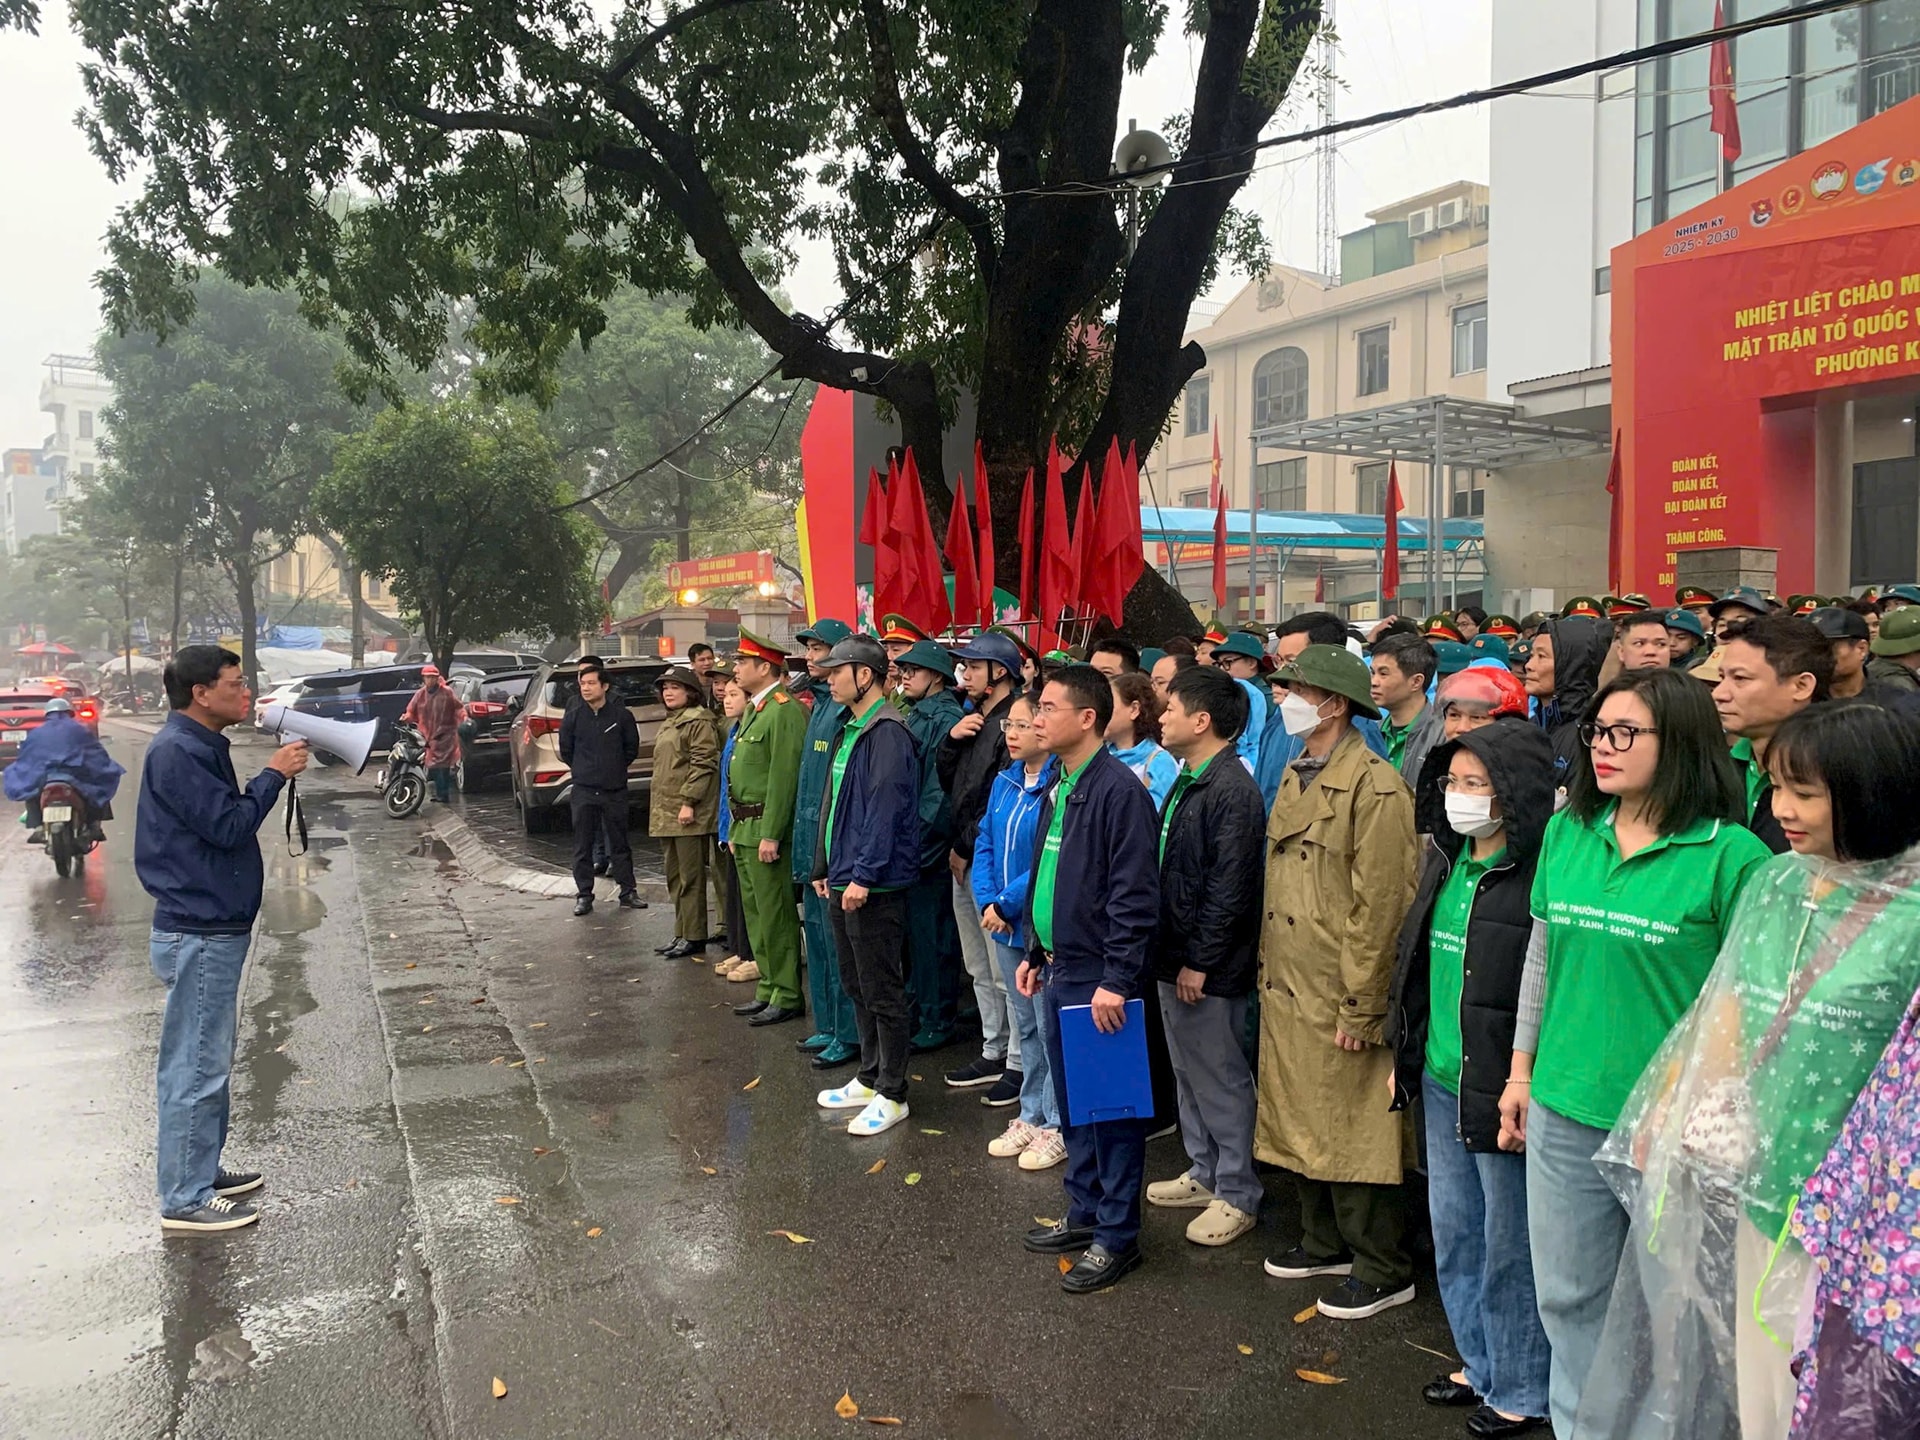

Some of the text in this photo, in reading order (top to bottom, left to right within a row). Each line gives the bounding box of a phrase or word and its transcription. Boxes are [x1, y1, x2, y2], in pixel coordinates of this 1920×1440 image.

[1664, 239, 1695, 257] 2025
[1706, 227, 1739, 246] 2030
[1735, 300, 1788, 329] NHIỆT
[1793, 290, 1833, 318] LIỆT
[1838, 279, 1894, 308] CHÀO
[1723, 335, 1763, 361] MẶT
[1767, 326, 1818, 352] TRẬN
[1823, 313, 1848, 343] TỔ
[1853, 304, 1909, 339] QUỐC
[1815, 345, 1899, 376] PHƯỜNG
[1672, 452, 1719, 473] ĐOÀN KẾT,
[1672, 473, 1719, 493] ĐOÀN KẾT,
[1664, 492, 1728, 516] ĐẠI ĐOÀN KẾT
[1665, 527, 1727, 545] THÀNH CÔNG,
[1658, 572, 1674, 587] ĐẠI
[1578, 918, 1604, 931] XANH
[1609, 924, 1636, 938] SẠCH
[1643, 932, 1665, 946] ĐẸP
[1607, 911, 1650, 927] KHƯƠNG
[1651, 920, 1680, 935] ĐÌNH
